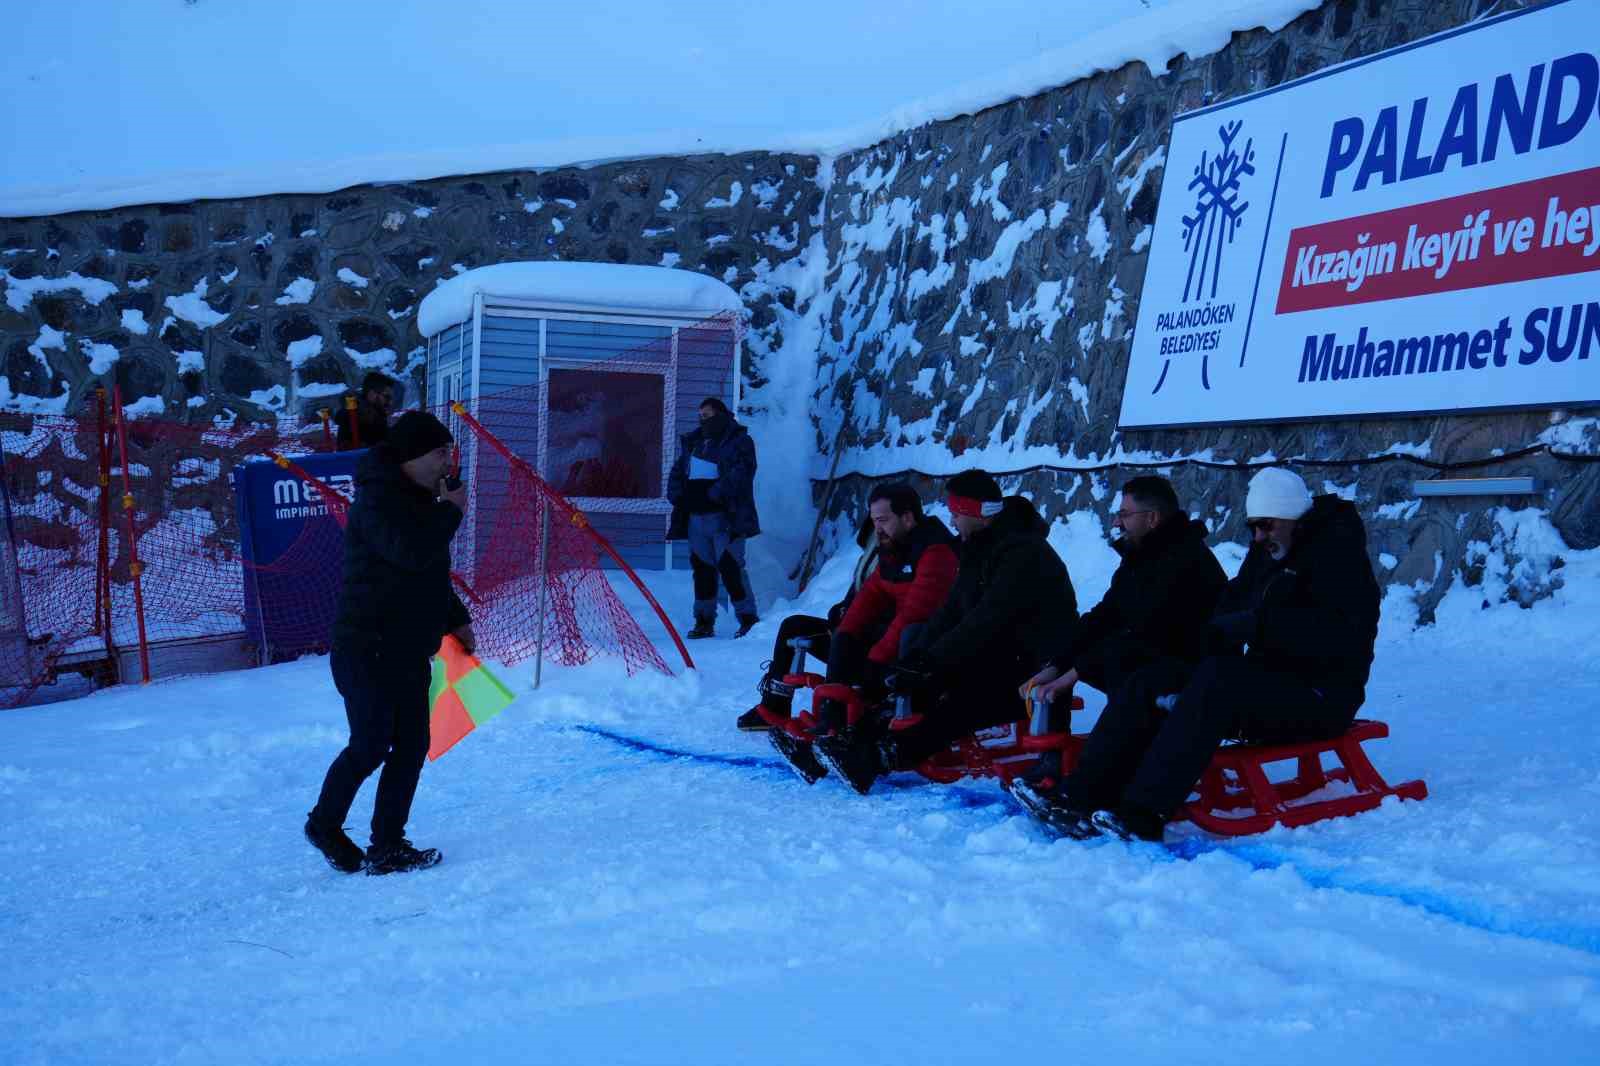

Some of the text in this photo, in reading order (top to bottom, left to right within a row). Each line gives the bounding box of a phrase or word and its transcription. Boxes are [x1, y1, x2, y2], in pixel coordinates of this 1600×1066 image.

[1320, 52, 1600, 199] PALAND
[1292, 232, 1398, 292] Kızağın
[1401, 209, 1491, 280] keyif
[1494, 216, 1535, 256] ve
[1155, 301, 1235, 332] PALANDÖKEN
[1160, 329, 1221, 355] BELEDİYESİ
[1298, 315, 1512, 383] Muhammet
